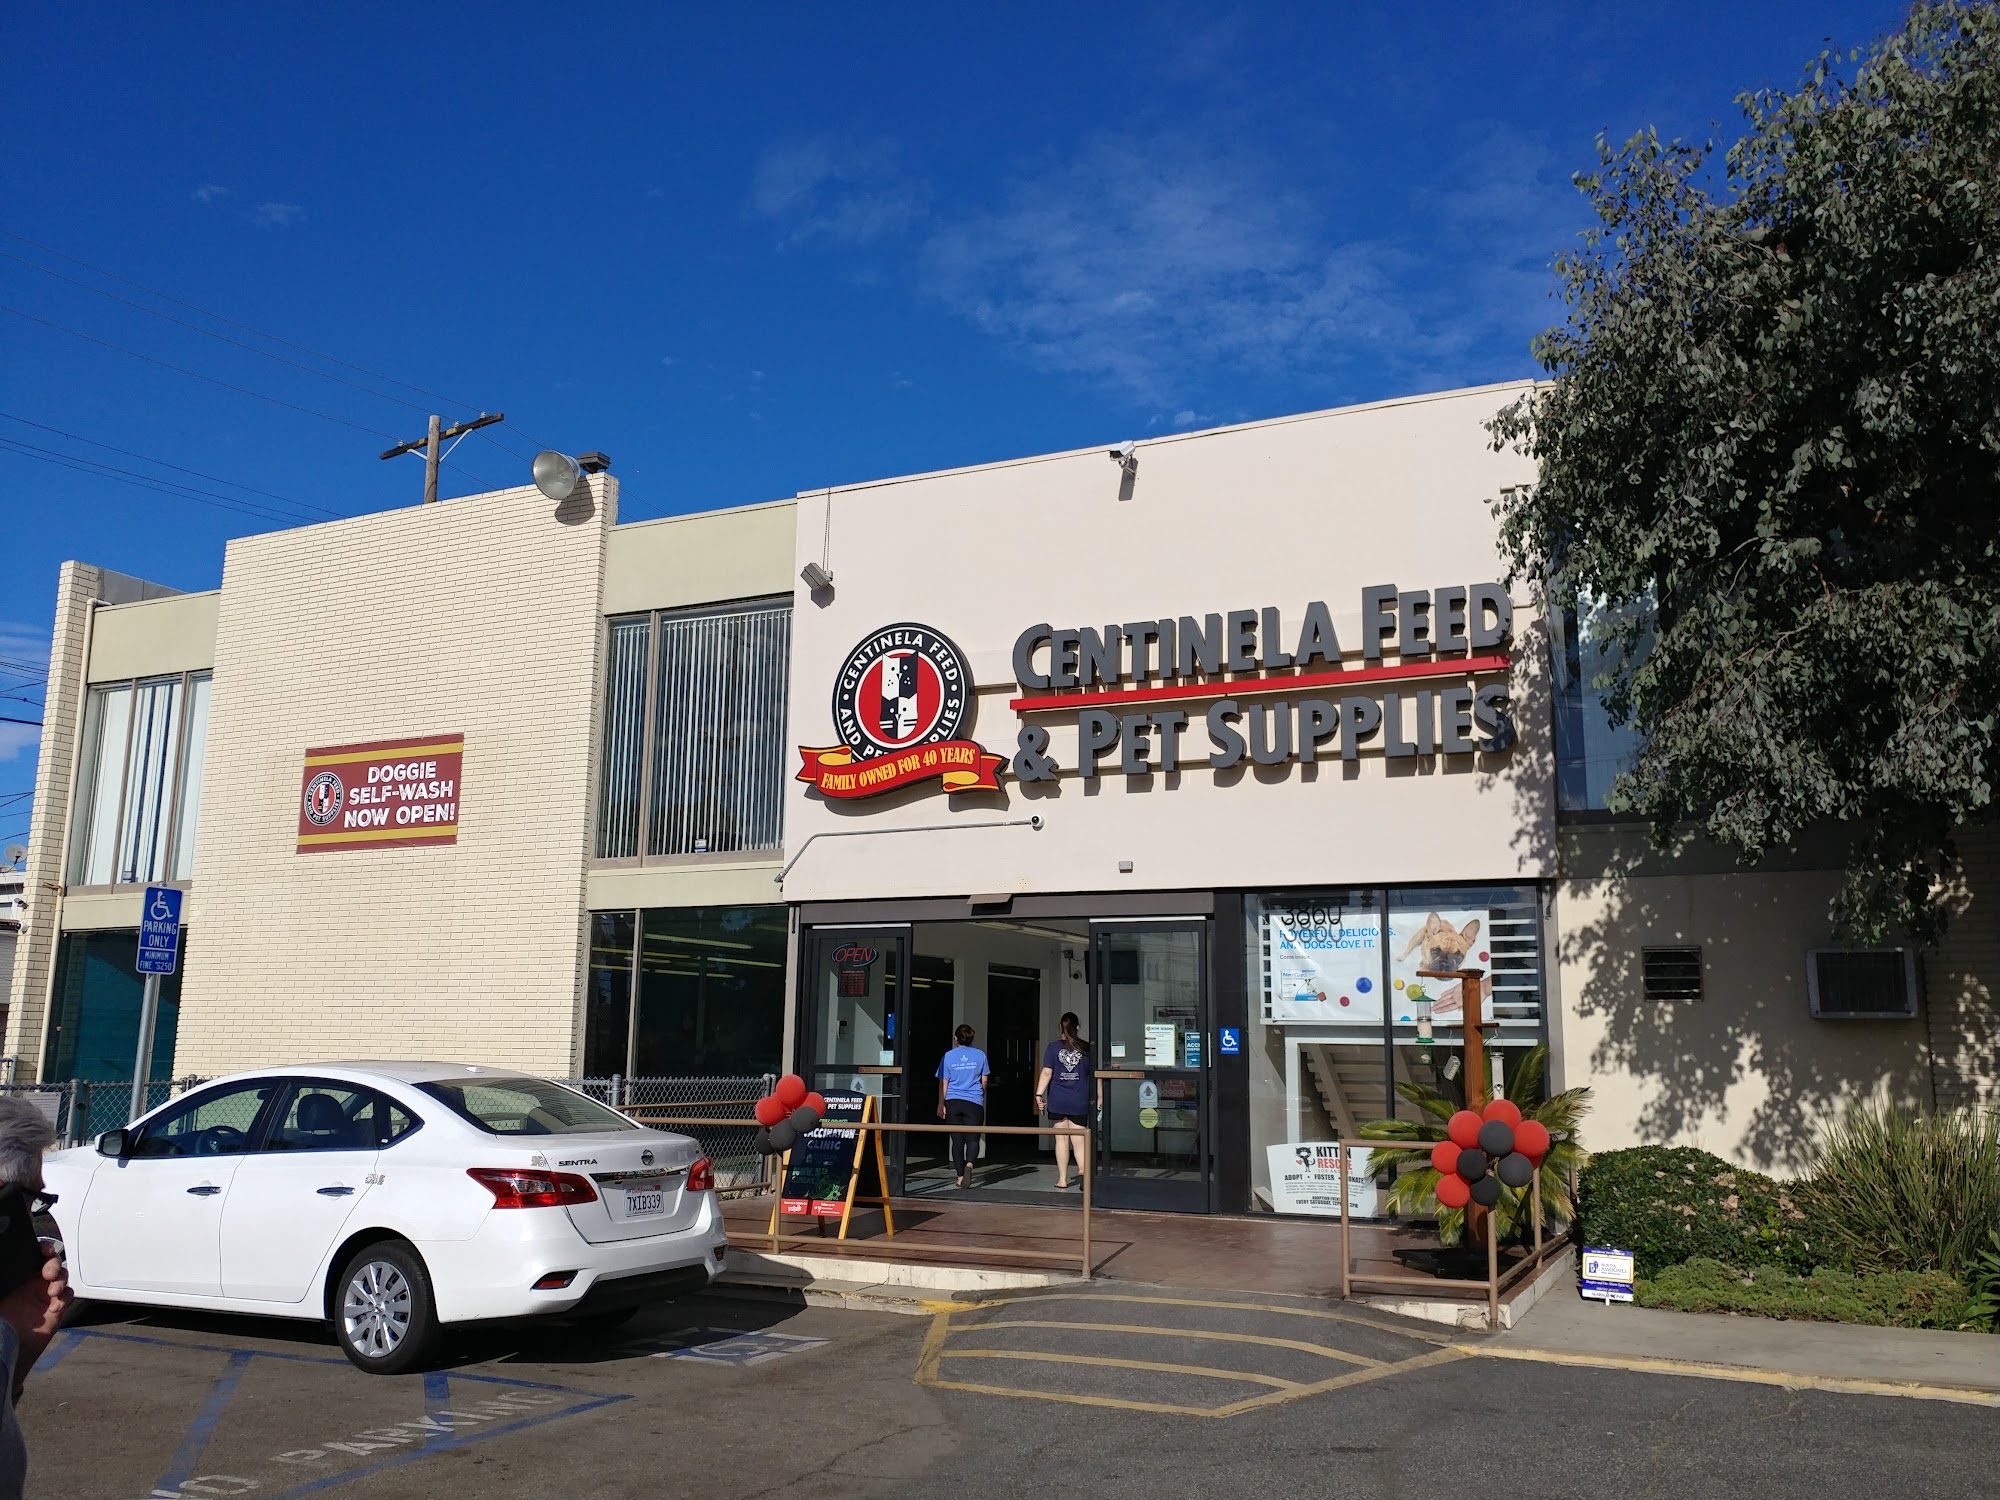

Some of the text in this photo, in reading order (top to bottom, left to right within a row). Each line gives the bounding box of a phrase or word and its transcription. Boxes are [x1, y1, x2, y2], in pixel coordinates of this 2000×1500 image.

[1012, 582, 1514, 690] CENTINELA FEED
[843, 631, 958, 690] CENTINELA FEED
[840, 708, 862, 746] AND
[1012, 683, 1519, 782] & PET SUPPLIES
[367, 761, 437, 784] DOGGIE
[821, 747, 976, 791] FAMILY OWNED FOR 40 YEARS
[348, 780, 454, 806] SELF-WASH
[343, 803, 456, 828] NOW OPEN!
[143, 920, 177, 934] PARKING
[1340, 928, 1396, 937] DELICIOS.
[148, 934, 170, 948] ONLY
[1304, 940, 1333, 949] DOGS
[1335, 939, 1361, 949] LOVE
[1363, 939, 1375, 948] IT.
[144, 950, 169, 960] MINIMUM
[835, 947, 873, 962] OPEN
[140, 961, 172, 971] FINE $250
[807, 1140, 841, 1150] CLINIC
[1315, 1146, 1352, 1159] KITTN
[558, 1158, 598, 1167] SENTRA
[1317, 1158, 1352, 1170] RESCE
[627, 1194, 661, 1212] 7XIB339
[270, 1391, 562, 1467] PARKING
